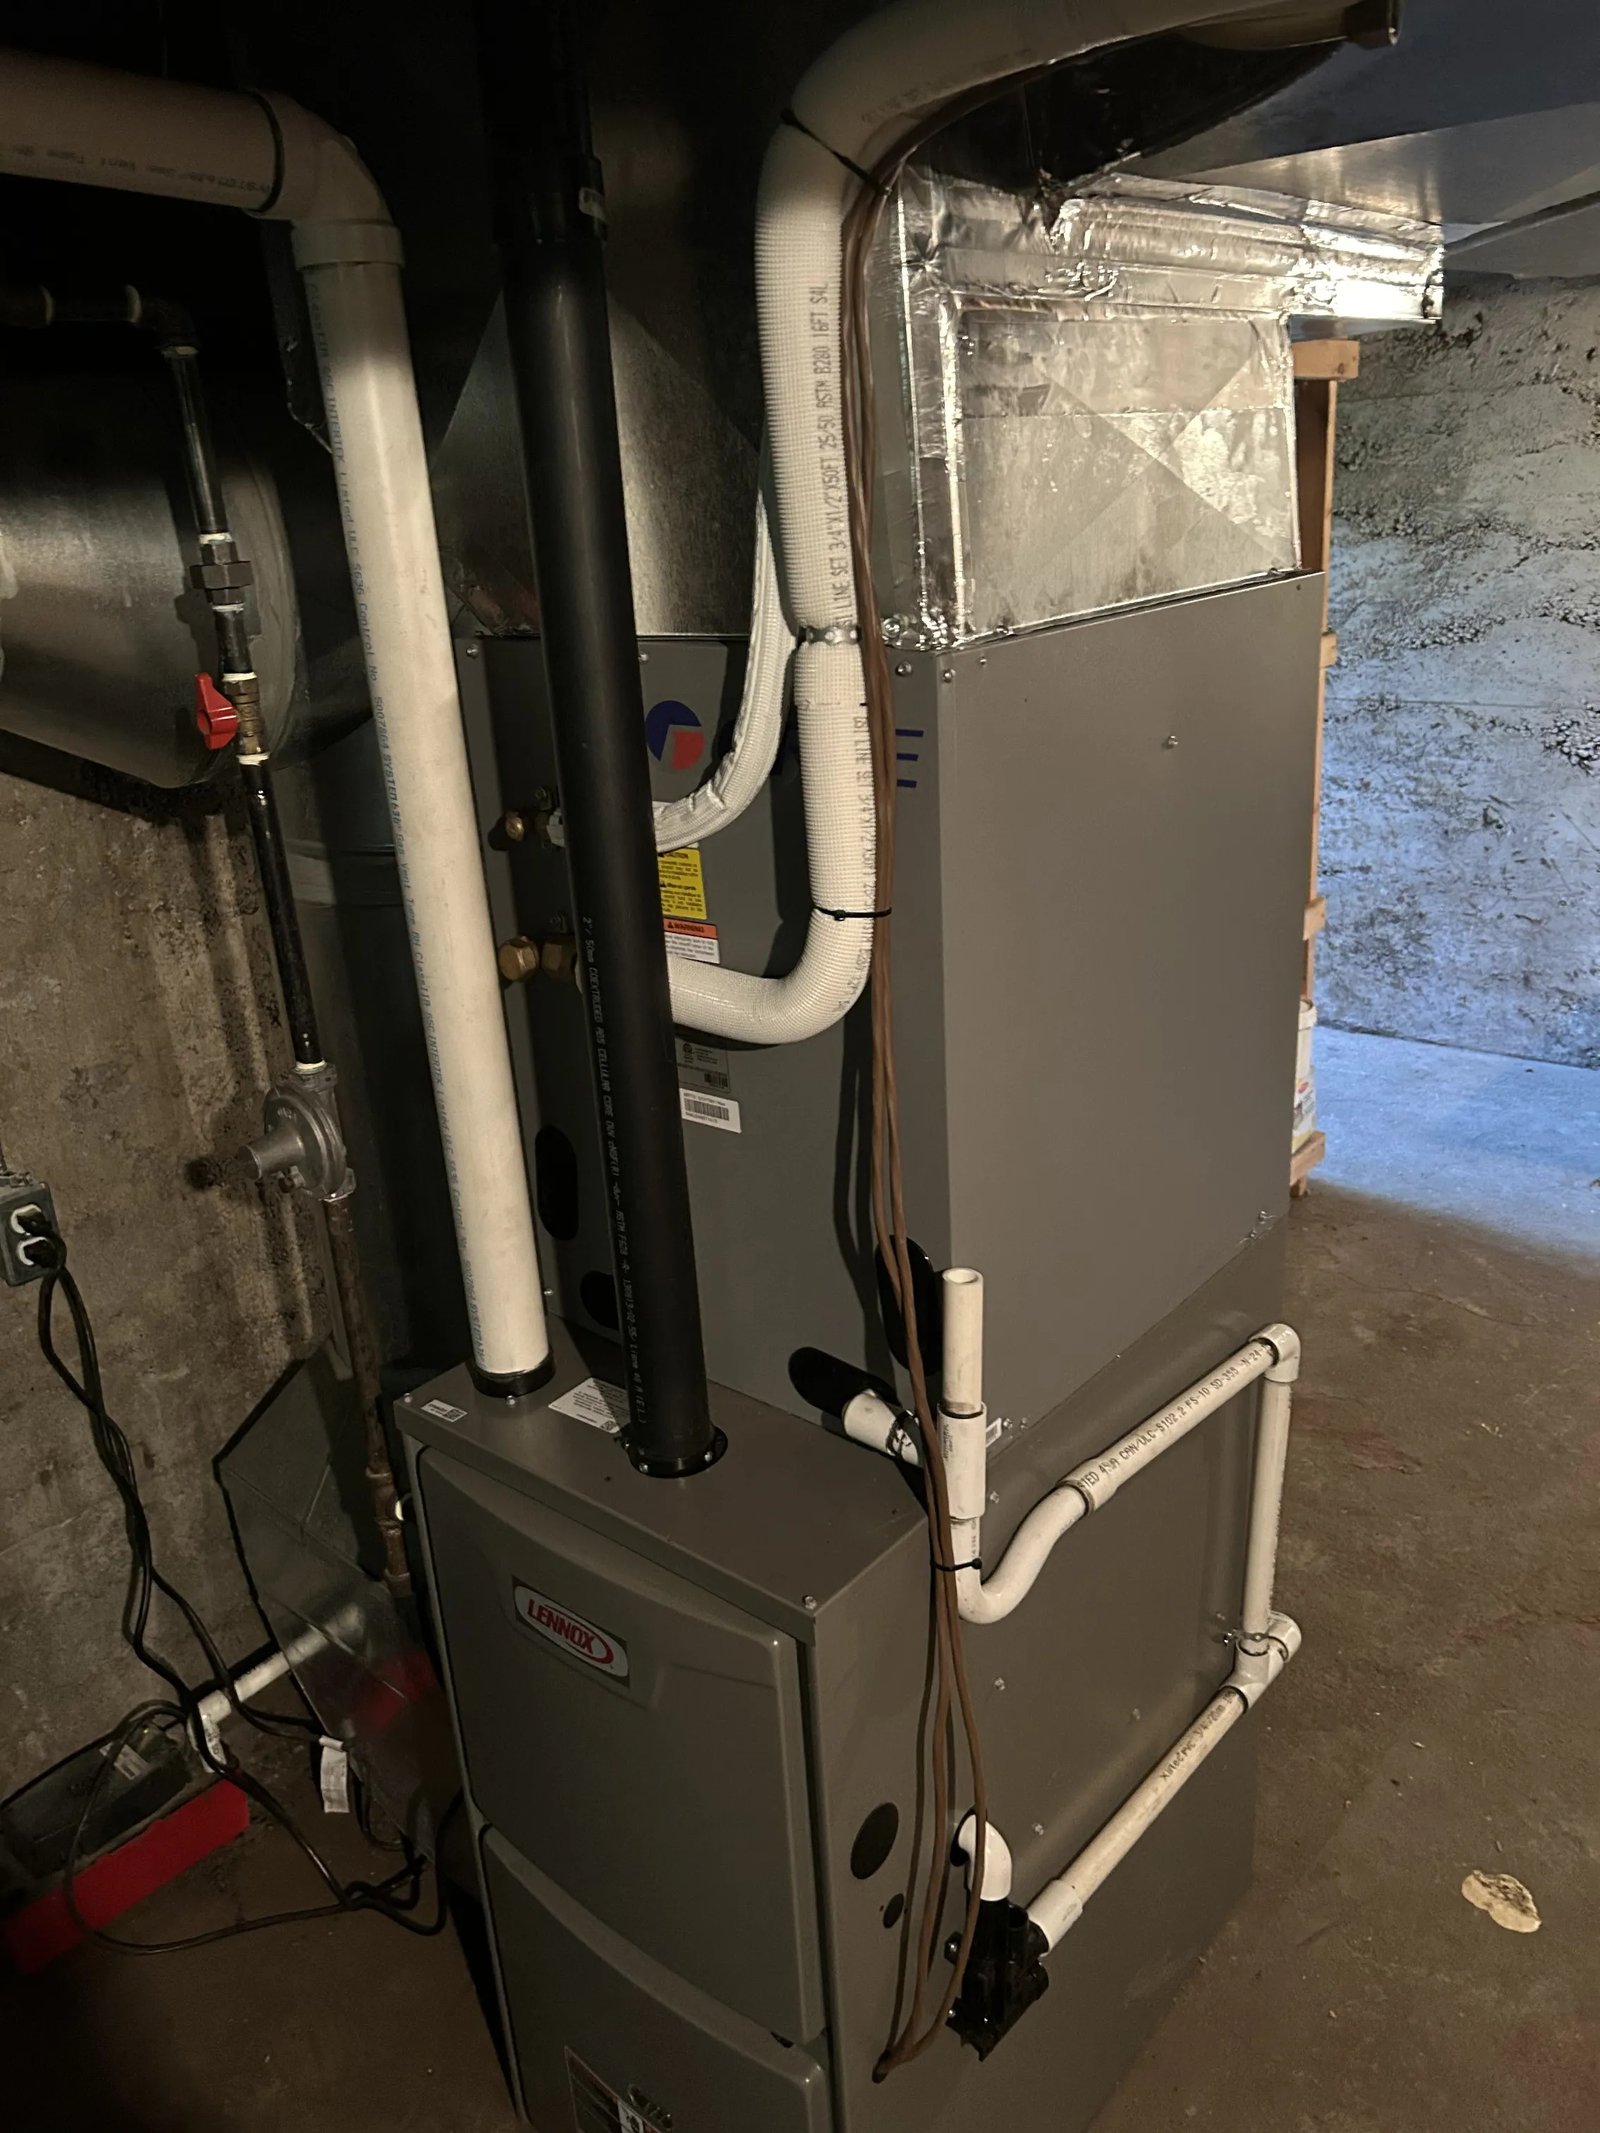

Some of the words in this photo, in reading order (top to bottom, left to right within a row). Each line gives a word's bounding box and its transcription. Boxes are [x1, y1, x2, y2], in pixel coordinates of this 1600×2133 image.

[810, 311, 829, 337] 16FT
[812, 345, 831, 374] B280
[814, 379, 832, 407] ASTM
[817, 415, 836, 449] 25/50
[828, 556, 848, 576] SET
[832, 581, 852, 609] LINE
[356, 601, 376, 656] Control
[587, 966, 603, 1023] COEXTRUDED
[596, 1046, 610, 1092] CELLULAR
[602, 1094, 613, 1117] CORE
[614, 1208, 626, 1232] ASTM
[1183, 1385, 1212, 1410] FS-10
[526, 1597, 598, 1657] LENNOX
